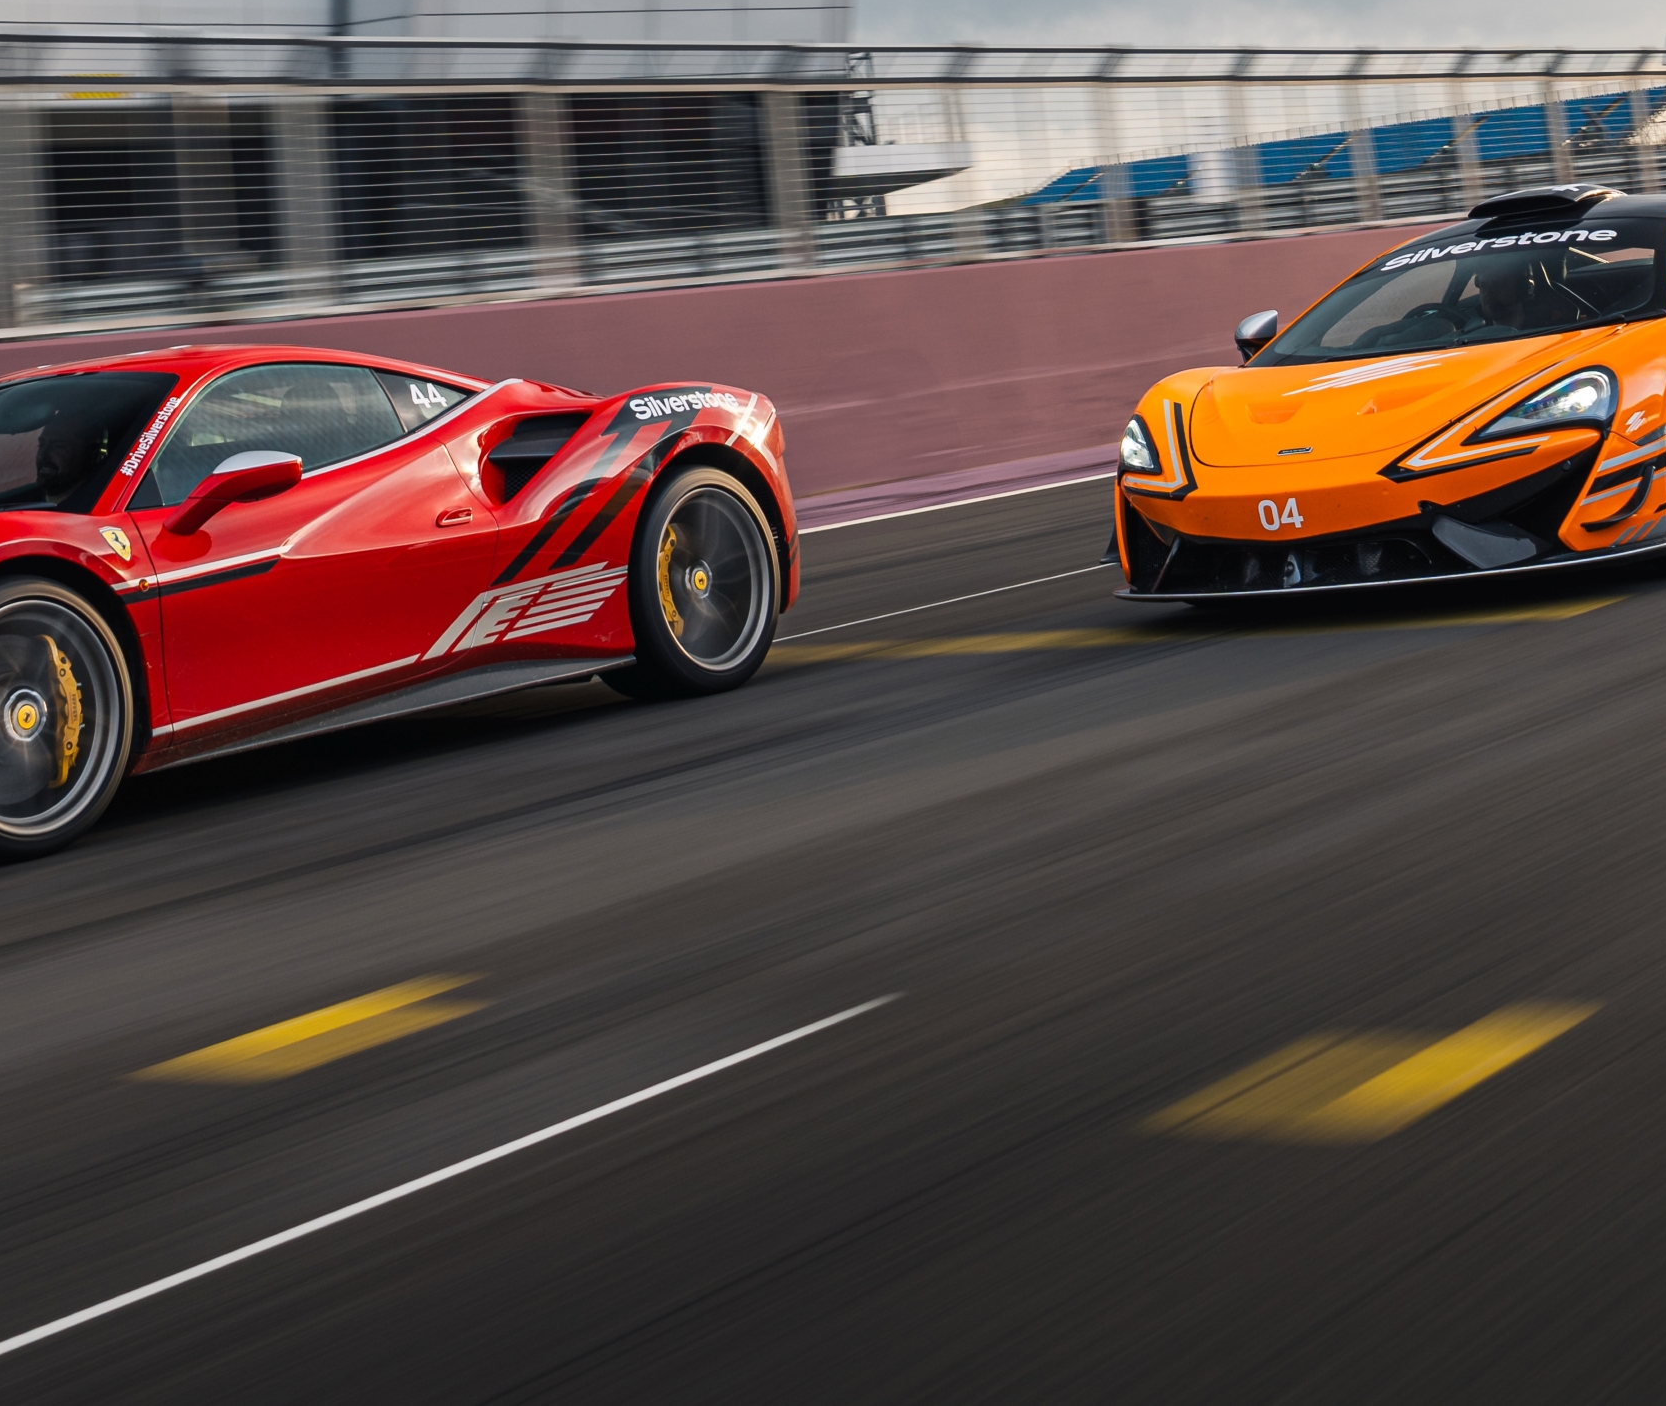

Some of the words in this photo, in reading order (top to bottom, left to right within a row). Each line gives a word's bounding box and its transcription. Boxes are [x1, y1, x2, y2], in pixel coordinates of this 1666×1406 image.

[1380, 229, 1617, 272] Silverstone
[409, 382, 448, 409] 44
[629, 391, 739, 420] Silverstone
[120, 396, 180, 477] #DriveSilverstone
[1258, 497, 1304, 531] 04
